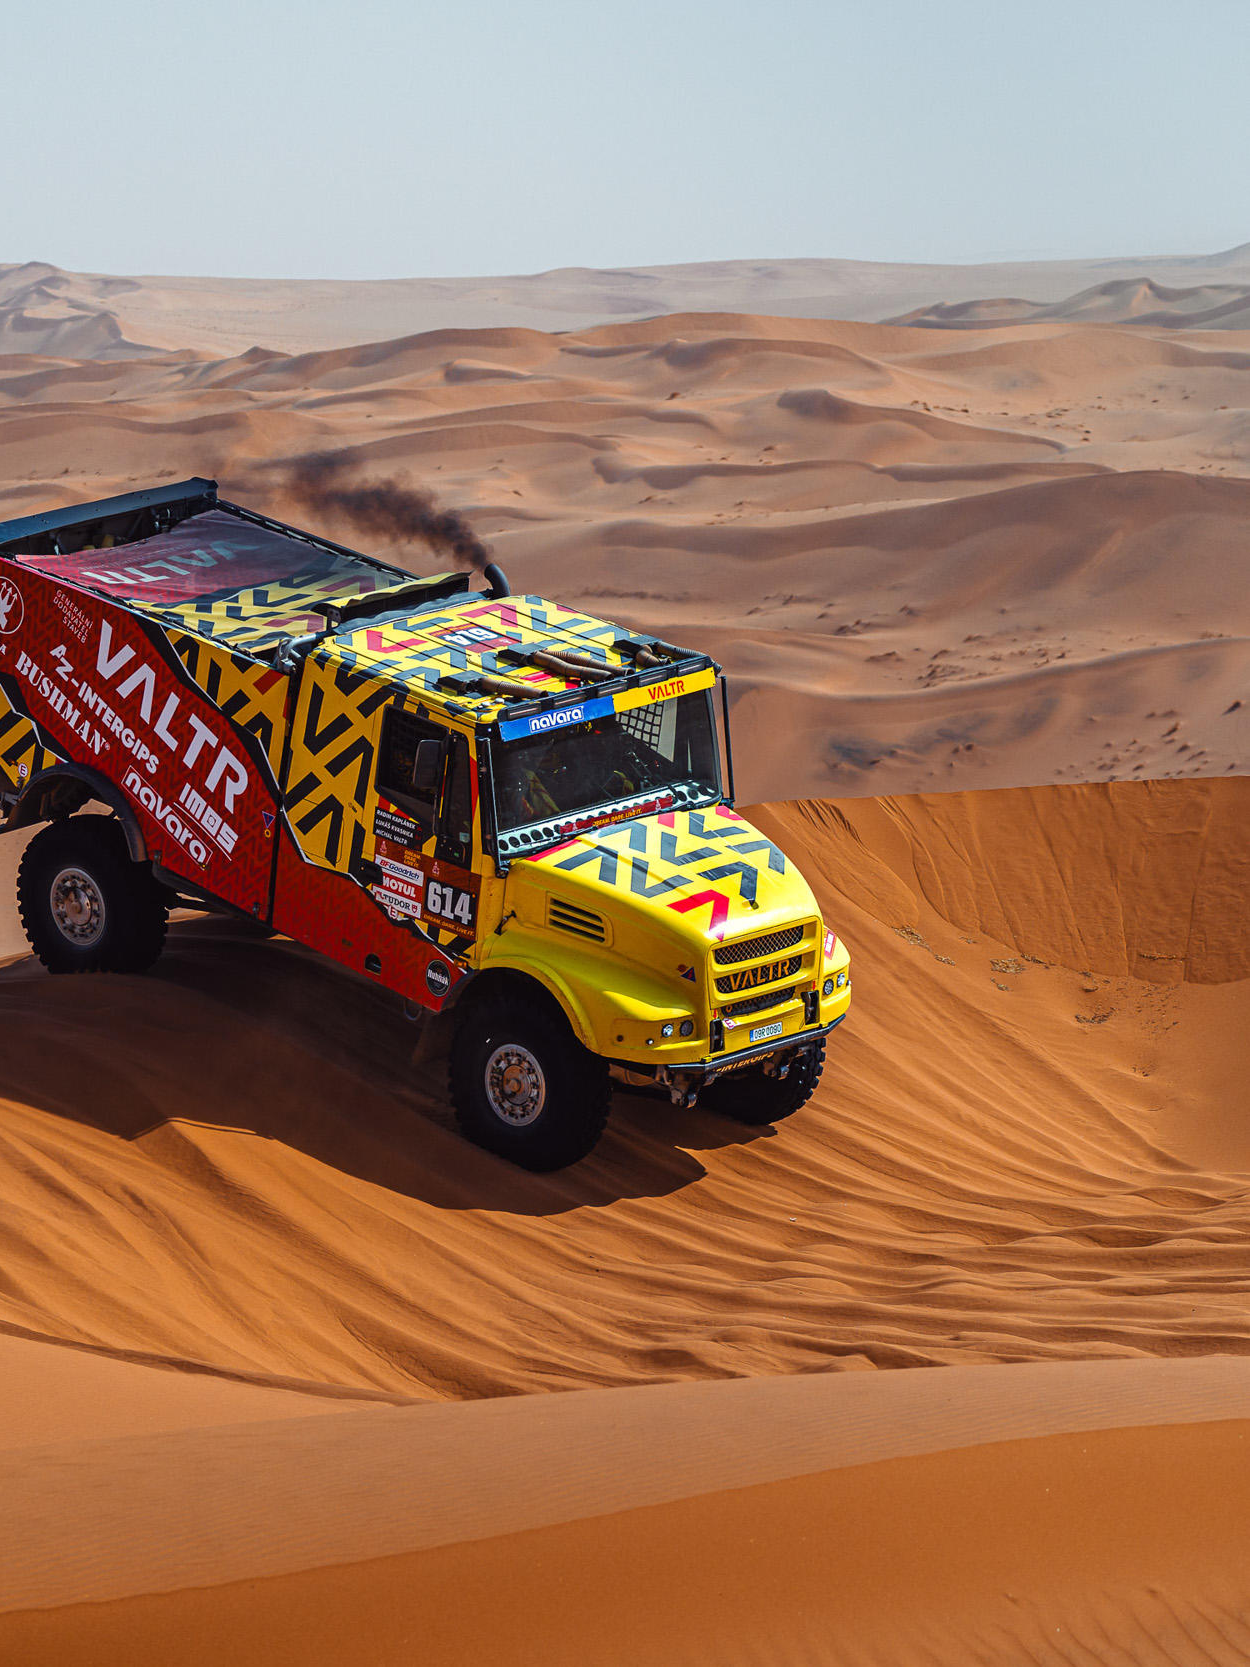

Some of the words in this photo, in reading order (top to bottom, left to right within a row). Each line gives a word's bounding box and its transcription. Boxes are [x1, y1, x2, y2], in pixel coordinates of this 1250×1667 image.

[53, 597, 89, 638] DODAVATEL
[62, 617, 86, 644] STAVEB
[648, 680, 686, 700] VALTR
[96, 619, 249, 815] VALTR
[531, 708, 583, 732] navara
[125, 772, 207, 863] navara
[383, 876, 416, 898] MOTUL
[383, 894, 410, 910] TUDOR
[427, 881, 472, 925] 614
[730, 959, 790, 991] VALTR
